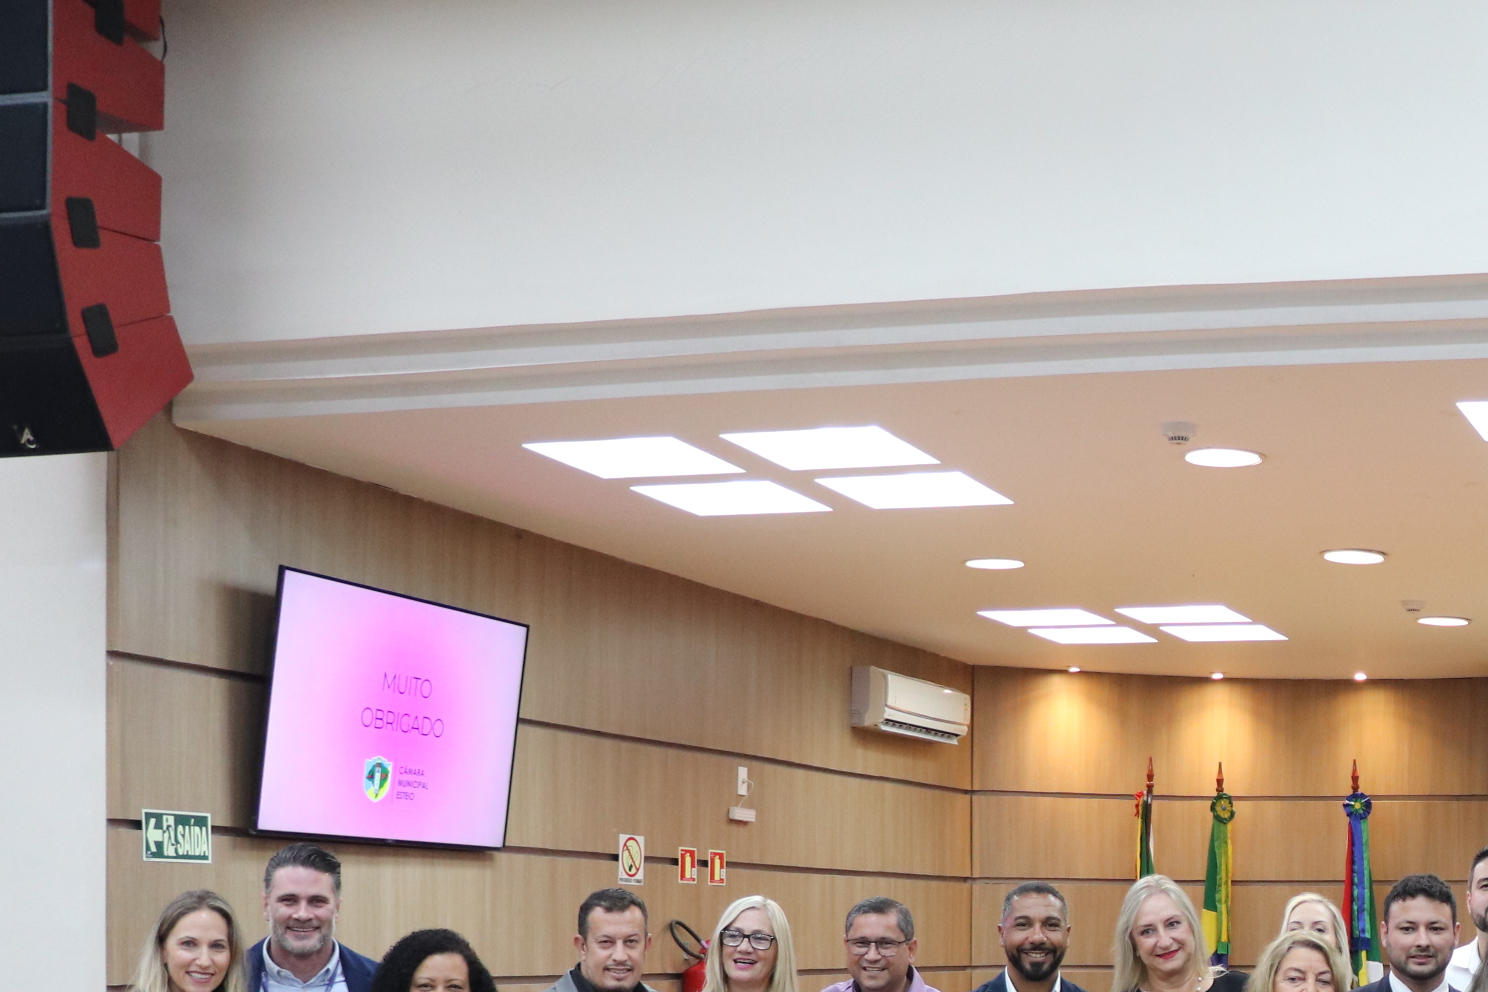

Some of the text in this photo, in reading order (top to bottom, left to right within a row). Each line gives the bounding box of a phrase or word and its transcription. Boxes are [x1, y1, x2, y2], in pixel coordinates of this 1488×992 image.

[382, 672, 432, 698] MUITO
[361, 707, 444, 738] OBRIGADO
[399, 765, 425, 776] CÂMARA
[397, 780, 429, 790] MUNICIPAL
[396, 791, 415, 801] ESTEIO
[177, 818, 209, 856] SAÍDA
